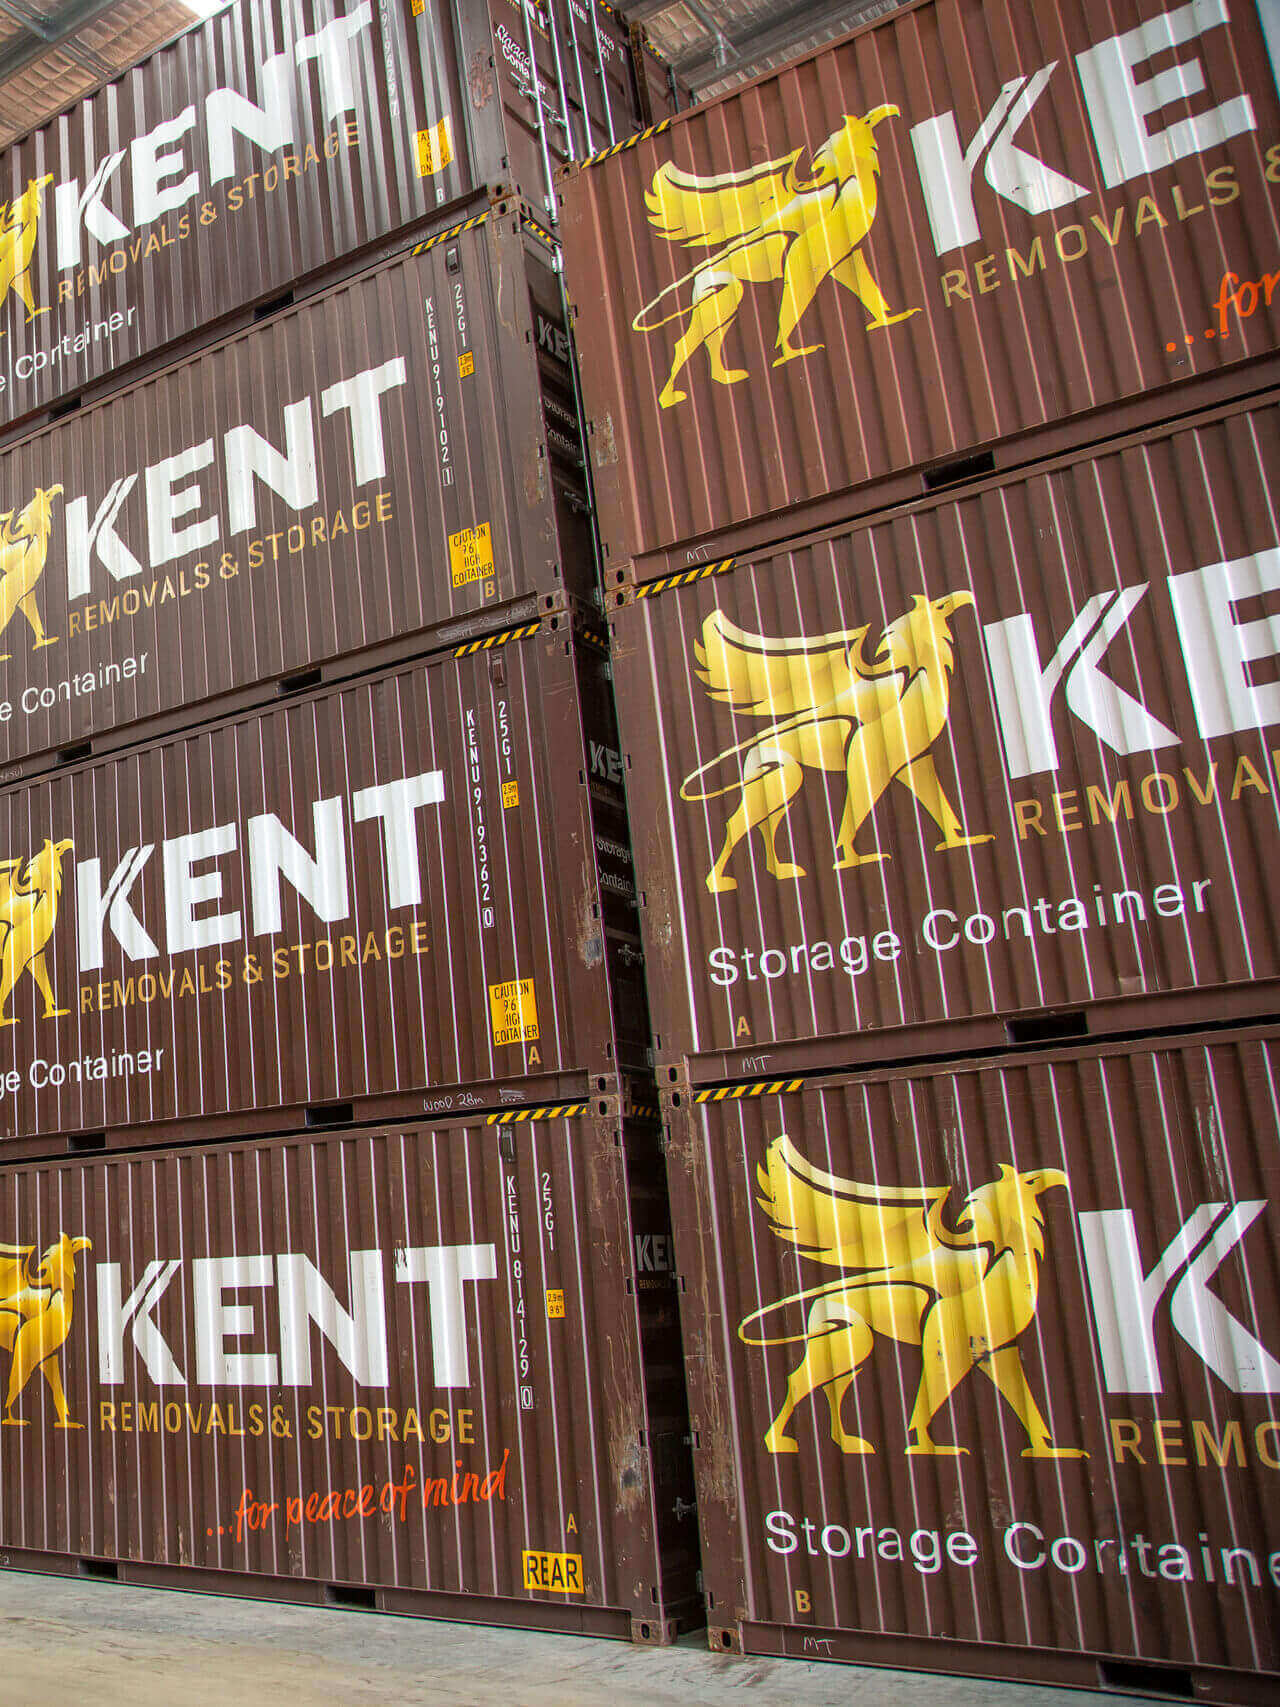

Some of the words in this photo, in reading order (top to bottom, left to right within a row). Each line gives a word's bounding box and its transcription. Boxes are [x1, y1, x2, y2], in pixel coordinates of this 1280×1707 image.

[54, 0, 373, 271] KENT
[910, 0, 1280, 256] KE
[58, 212, 191, 304] REMOVALS
[199, 201, 218, 226] &
[227, 121, 361, 211] STORAGE
[940, 165, 1242, 307] REMOVALS
[14, 304, 136, 380] Container
[454, 283, 467, 347] 25G1
[425, 296, 438, 361] KENU
[432, 363, 449, 463] 919102
[65, 357, 407, 600] KENT
[68, 562, 210, 639] REMOVALS
[218, 553, 240, 579] &
[248, 492, 393, 568] STORAGE
[484, 580, 495, 599] B
[21, 651, 149, 714] Container
[498, 701, 512, 775] 25G1
[466, 709, 480, 783] KENU
[473, 787, 490, 901] 919362
[76, 770, 445, 972] KENT
[80, 959, 232, 1014] REMOVALS
[242, 953, 263, 983] &
[272, 921, 429, 980] STORAGE
[709, 928, 901, 986] Storage
[922, 877, 1211, 953] Container
[528, 1045, 541, 1065] A
[736, 1015, 751, 1038] A
[28, 1047, 165, 1090] Container
[506, 1175, 521, 1253] KENU
[541, 1172, 555, 1251] 25G1
[635, 1234, 673, 1271] KE
[95, 1243, 498, 1388] KENT
[513, 1259, 529, 1378] 814129
[100, 1400, 264, 1437] REMOVALS
[271, 1404, 292, 1439] &
[306, 1405, 476, 1446] STORAGE
[286, 1483, 375, 1543] peace
[382, 1461, 419, 1523] of
[422, 1448, 511, 1507] mind
[567, 1513, 577, 1535] A
[526, 1555, 581, 1592] REAR
[765, 1511, 978, 1573] Storage
[795, 1589, 811, 1613] B
